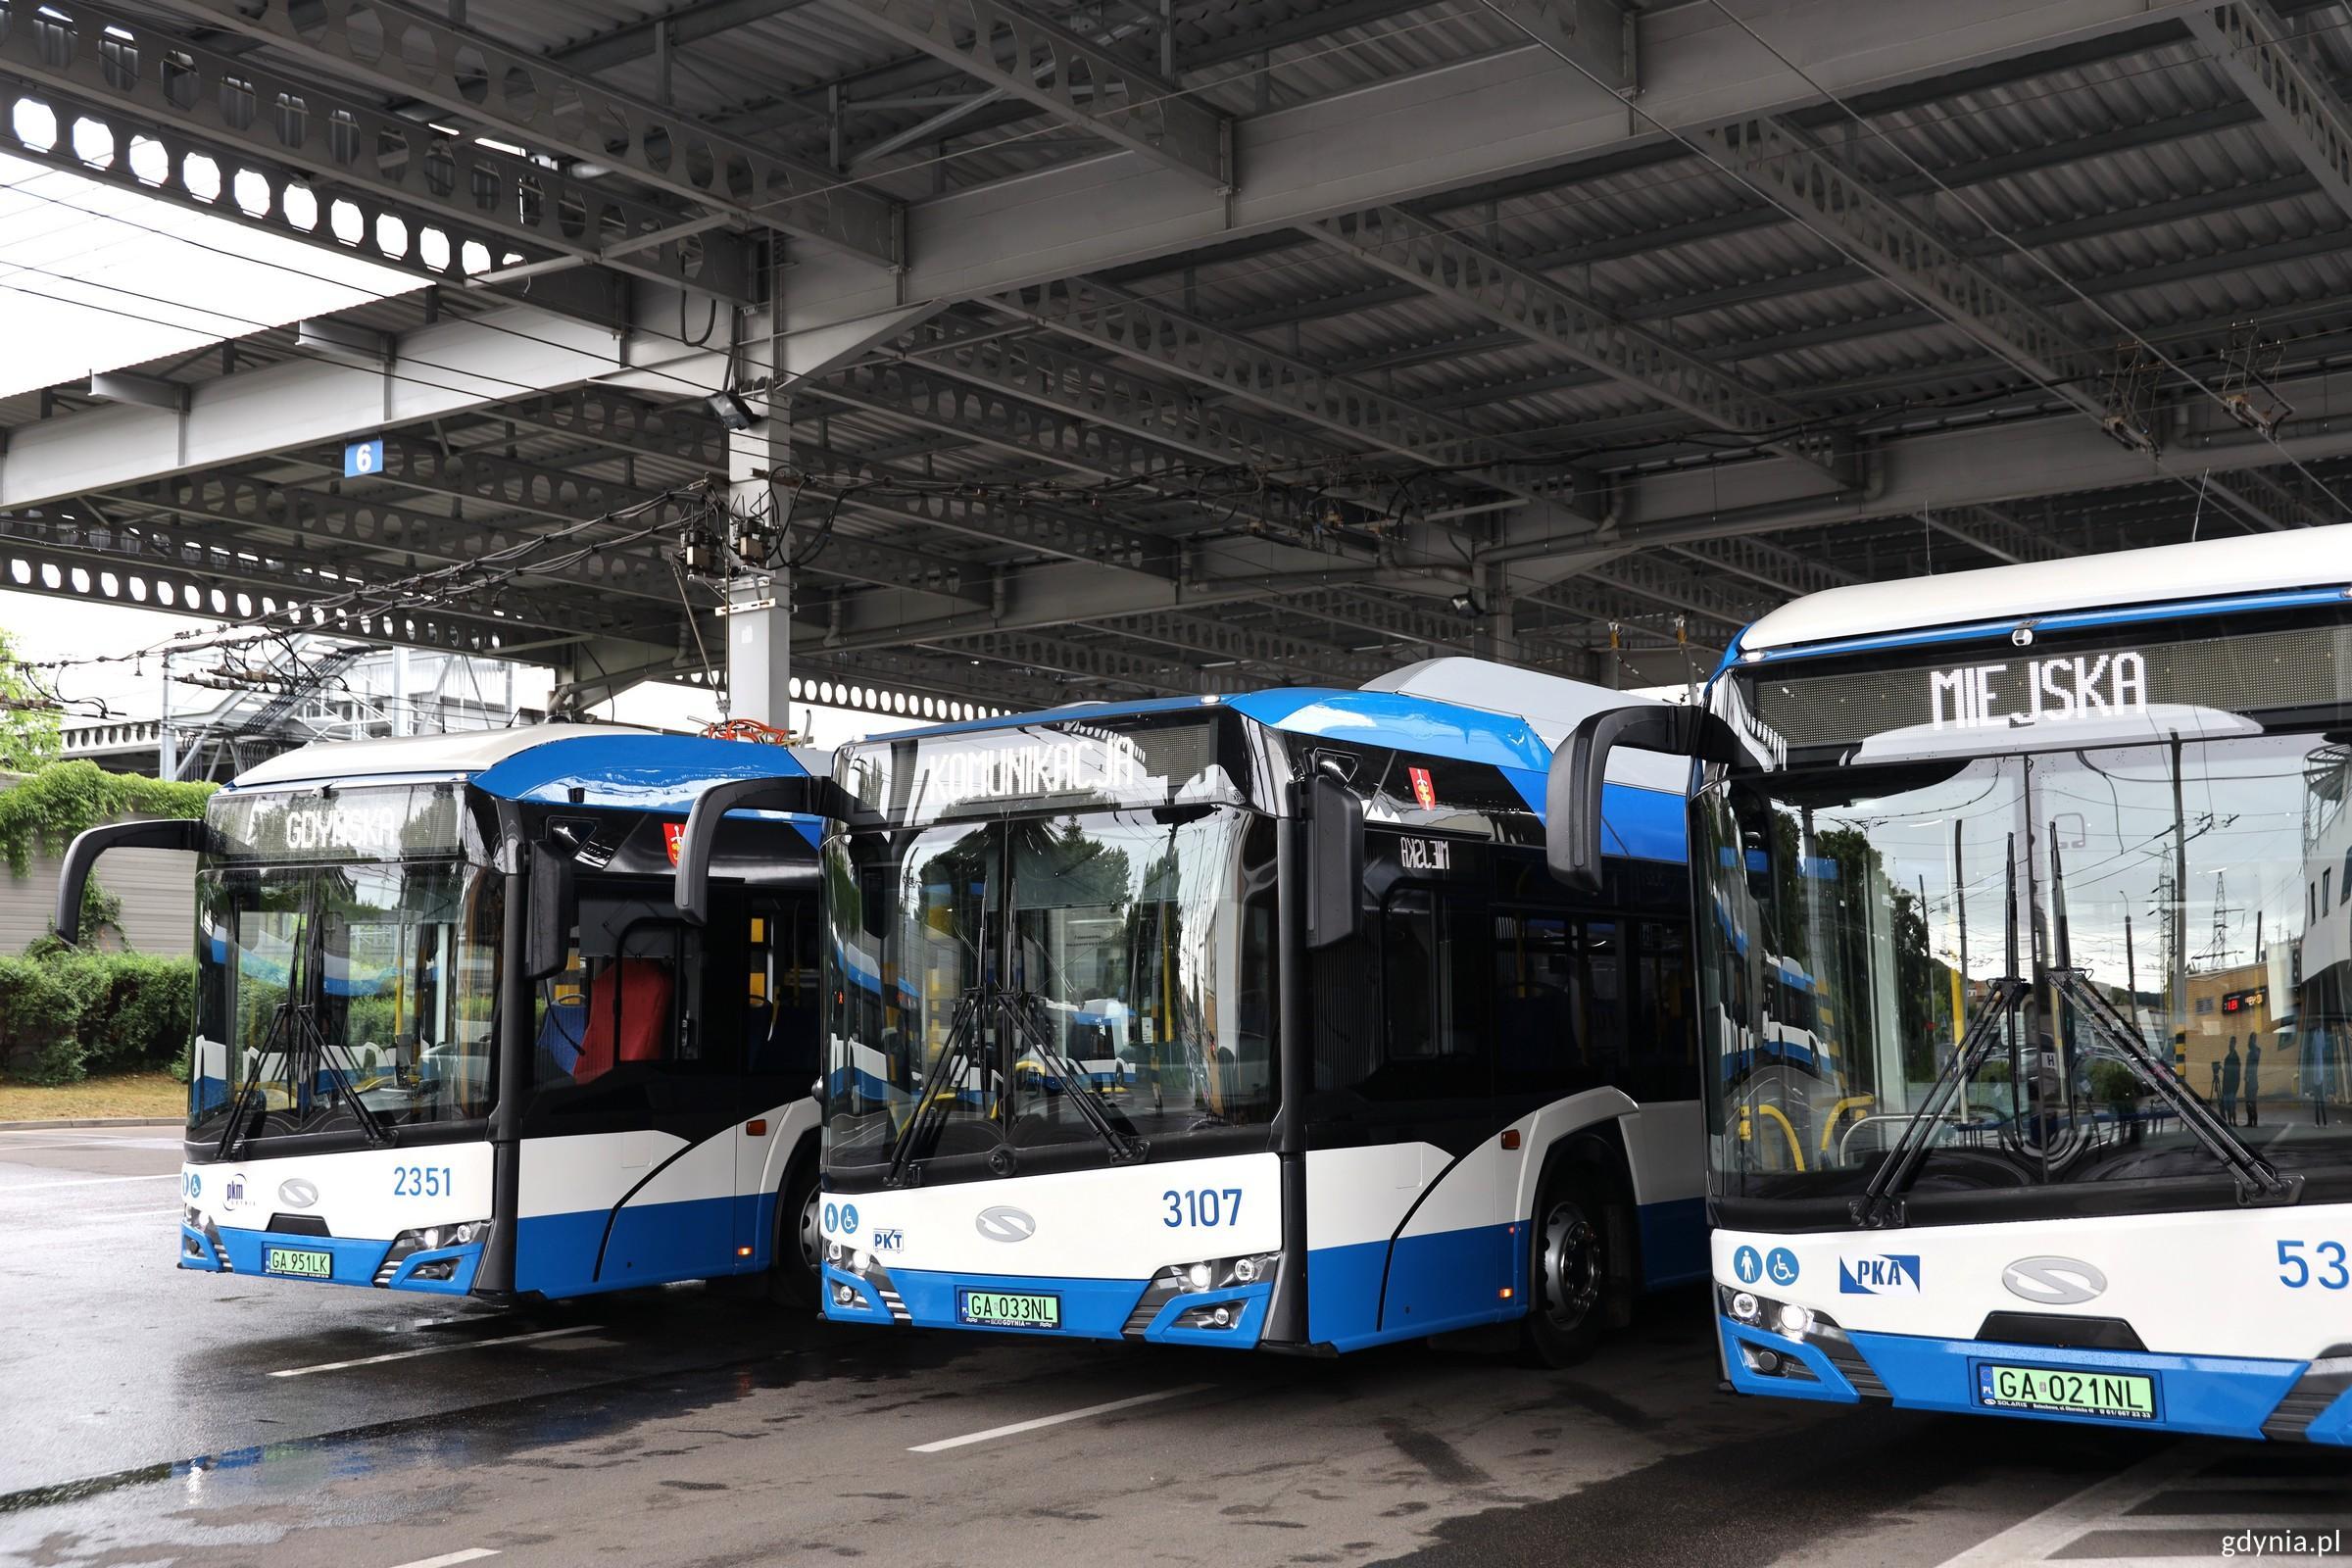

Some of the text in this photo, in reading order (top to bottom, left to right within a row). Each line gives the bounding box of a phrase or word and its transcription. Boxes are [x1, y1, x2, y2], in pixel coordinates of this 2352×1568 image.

[357, 444, 371, 472] 6
[1931, 652, 2146, 730] MIEJSKA
[927, 737, 1134, 801] KOMUNIKACJA
[226, 1180, 243, 1201] pkm
[394, 1166, 450, 1197] 2351
[1163, 1189, 1242, 1228] 3107
[874, 1229, 903, 1250] PKT
[272, 1251, 327, 1273] GA 951LK
[1858, 1260, 1901, 1285] PKA
[2277, 1240, 2350, 1290] 53
[972, 1295, 1054, 1321] GA 033NL
[1983, 1386, 1993, 1395] PL
[1997, 1399, 2028, 1408] SOLARIS
[1999, 1371, 2143, 1409] GA 021NL
